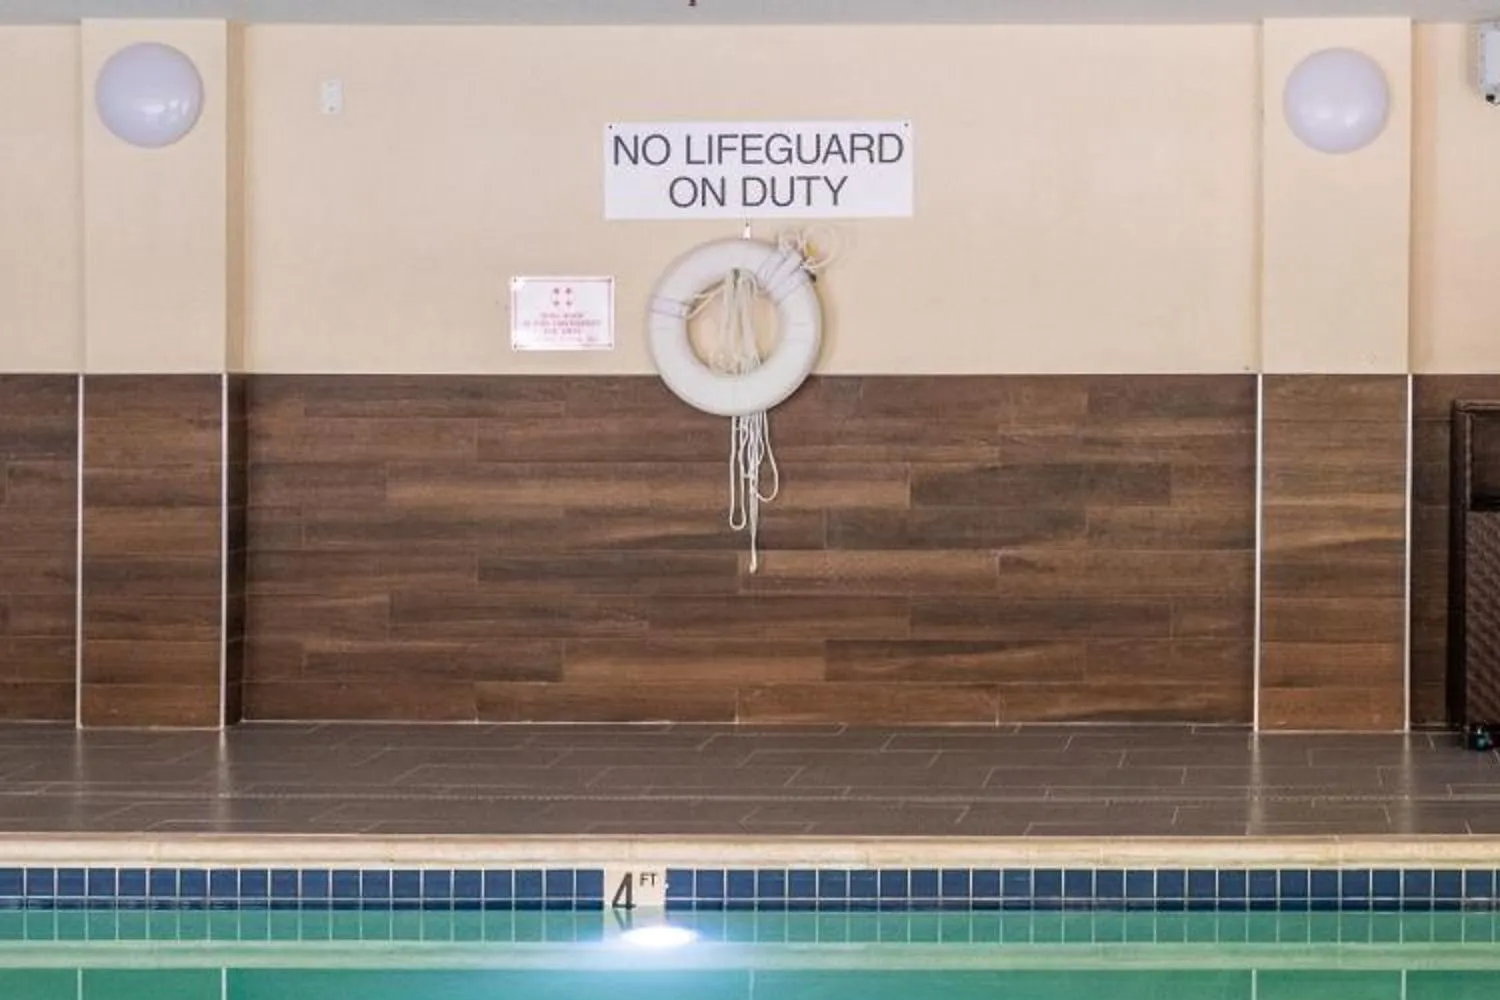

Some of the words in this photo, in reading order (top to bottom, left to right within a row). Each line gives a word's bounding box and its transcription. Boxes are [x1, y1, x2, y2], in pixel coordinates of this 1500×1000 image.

[613, 134, 671, 166] NO
[685, 132, 905, 166] LIFEGUARD
[669, 175, 726, 208] ON
[741, 174, 848, 207] DUTY
[611, 871, 637, 911] 4
[639, 872, 658, 888] FT
